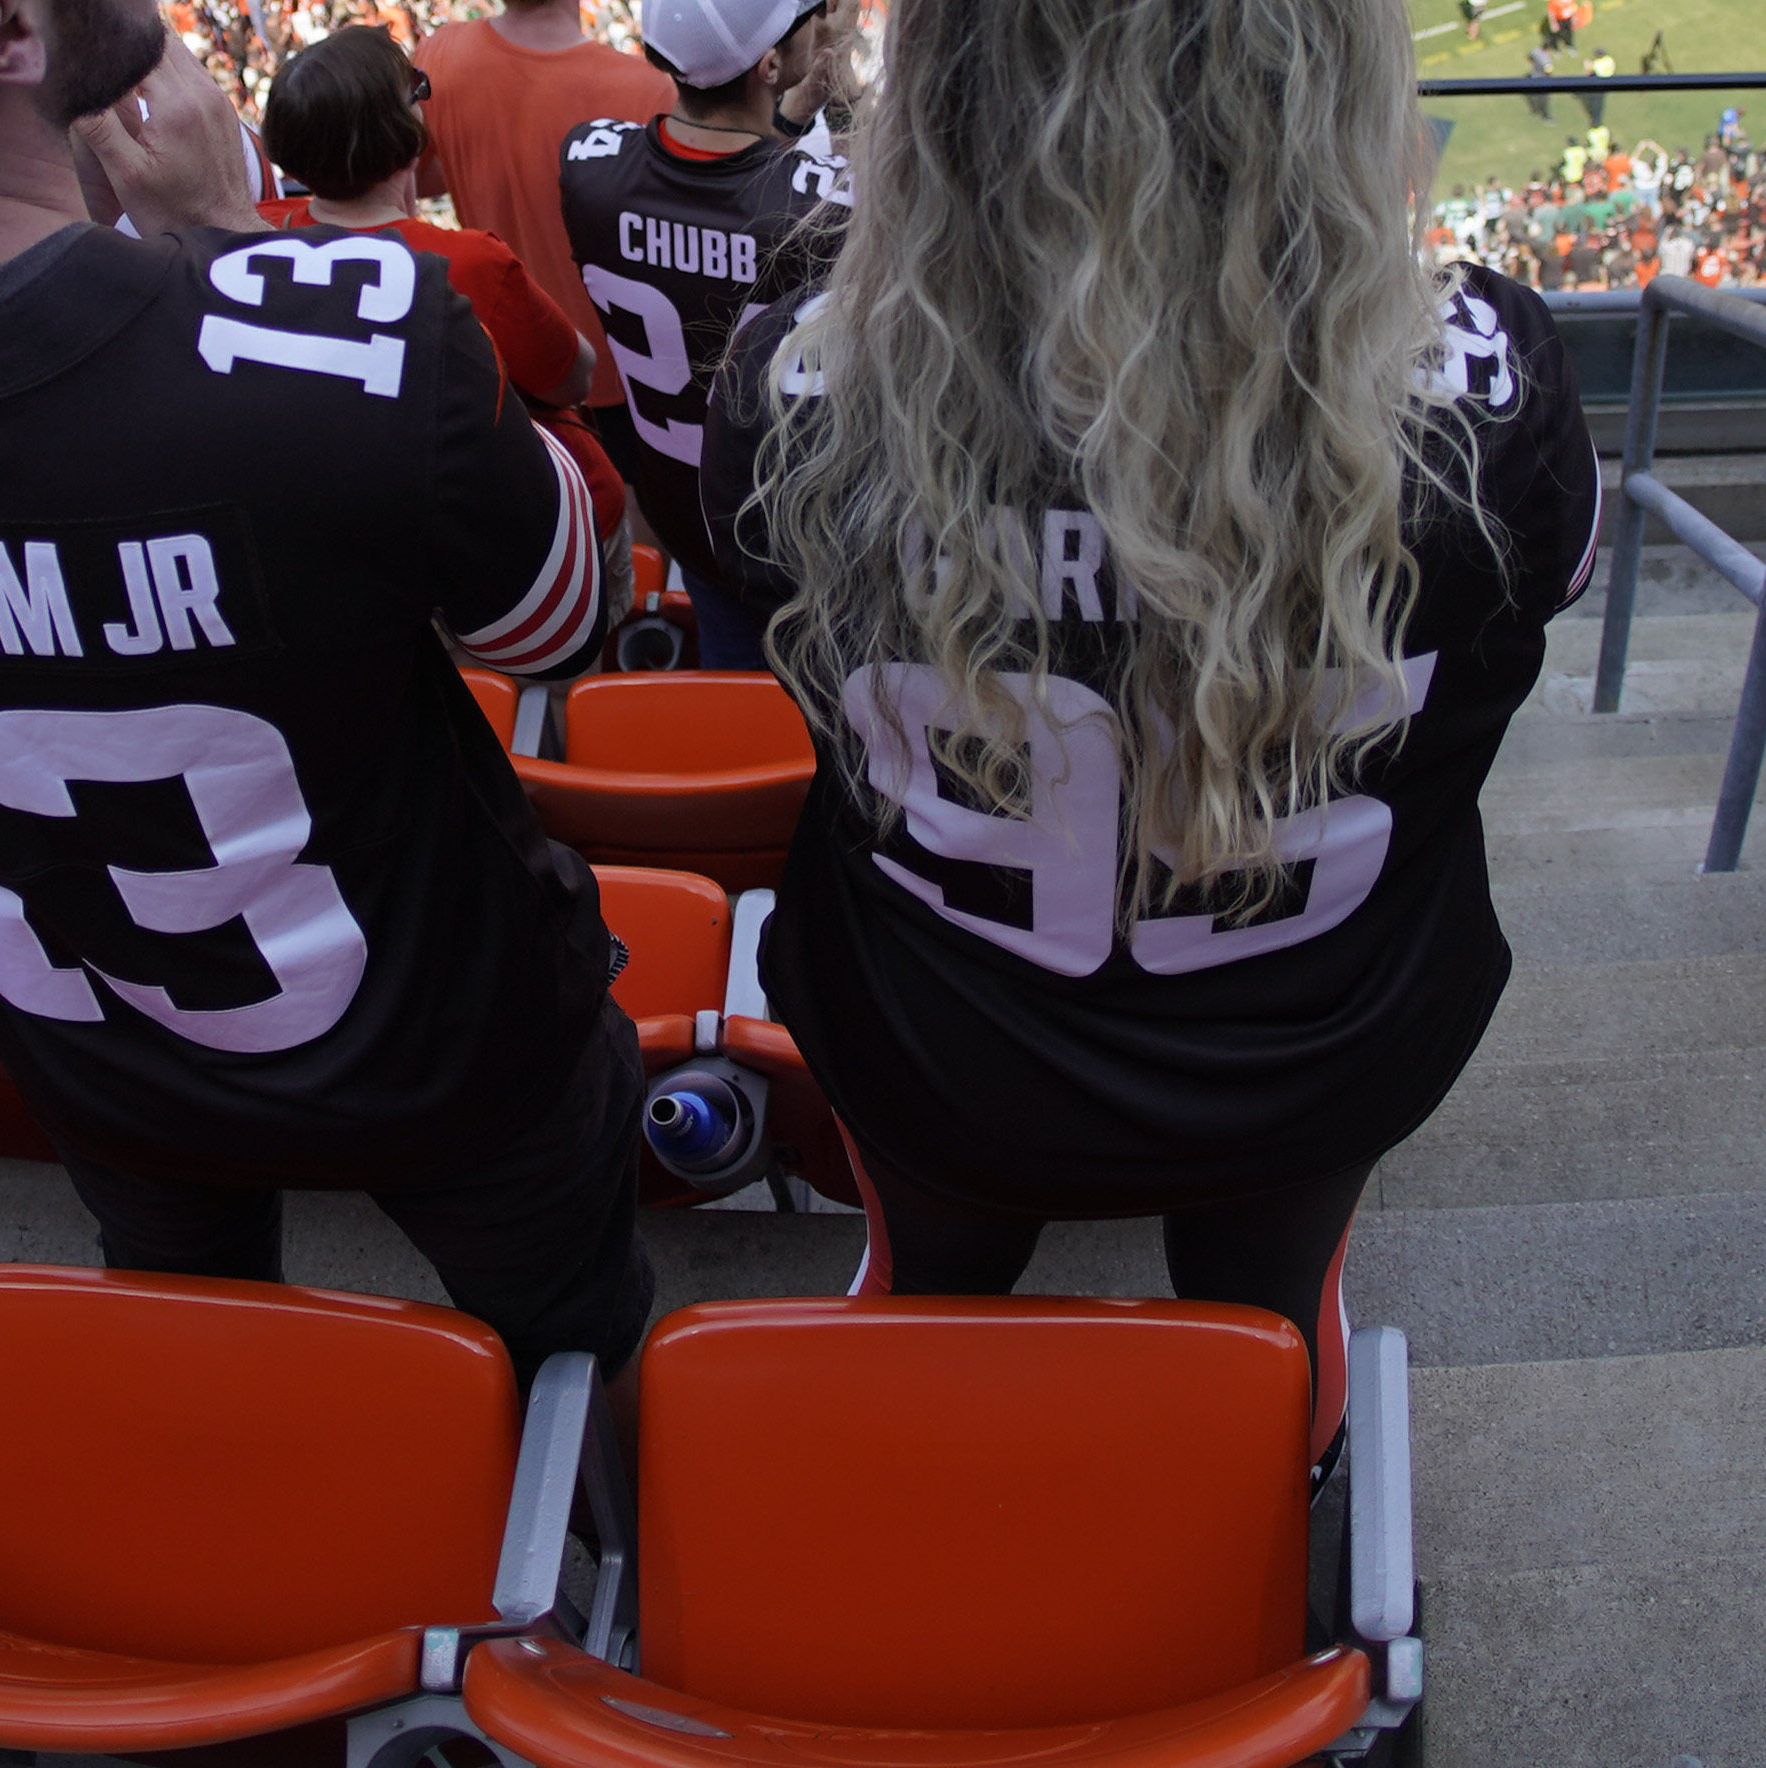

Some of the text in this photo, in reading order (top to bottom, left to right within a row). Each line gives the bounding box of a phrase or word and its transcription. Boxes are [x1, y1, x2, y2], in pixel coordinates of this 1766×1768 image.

[617, 209, 758, 285] CHUBB
[197, 236, 417, 399] 13
[101, 533, 236, 659] JR
